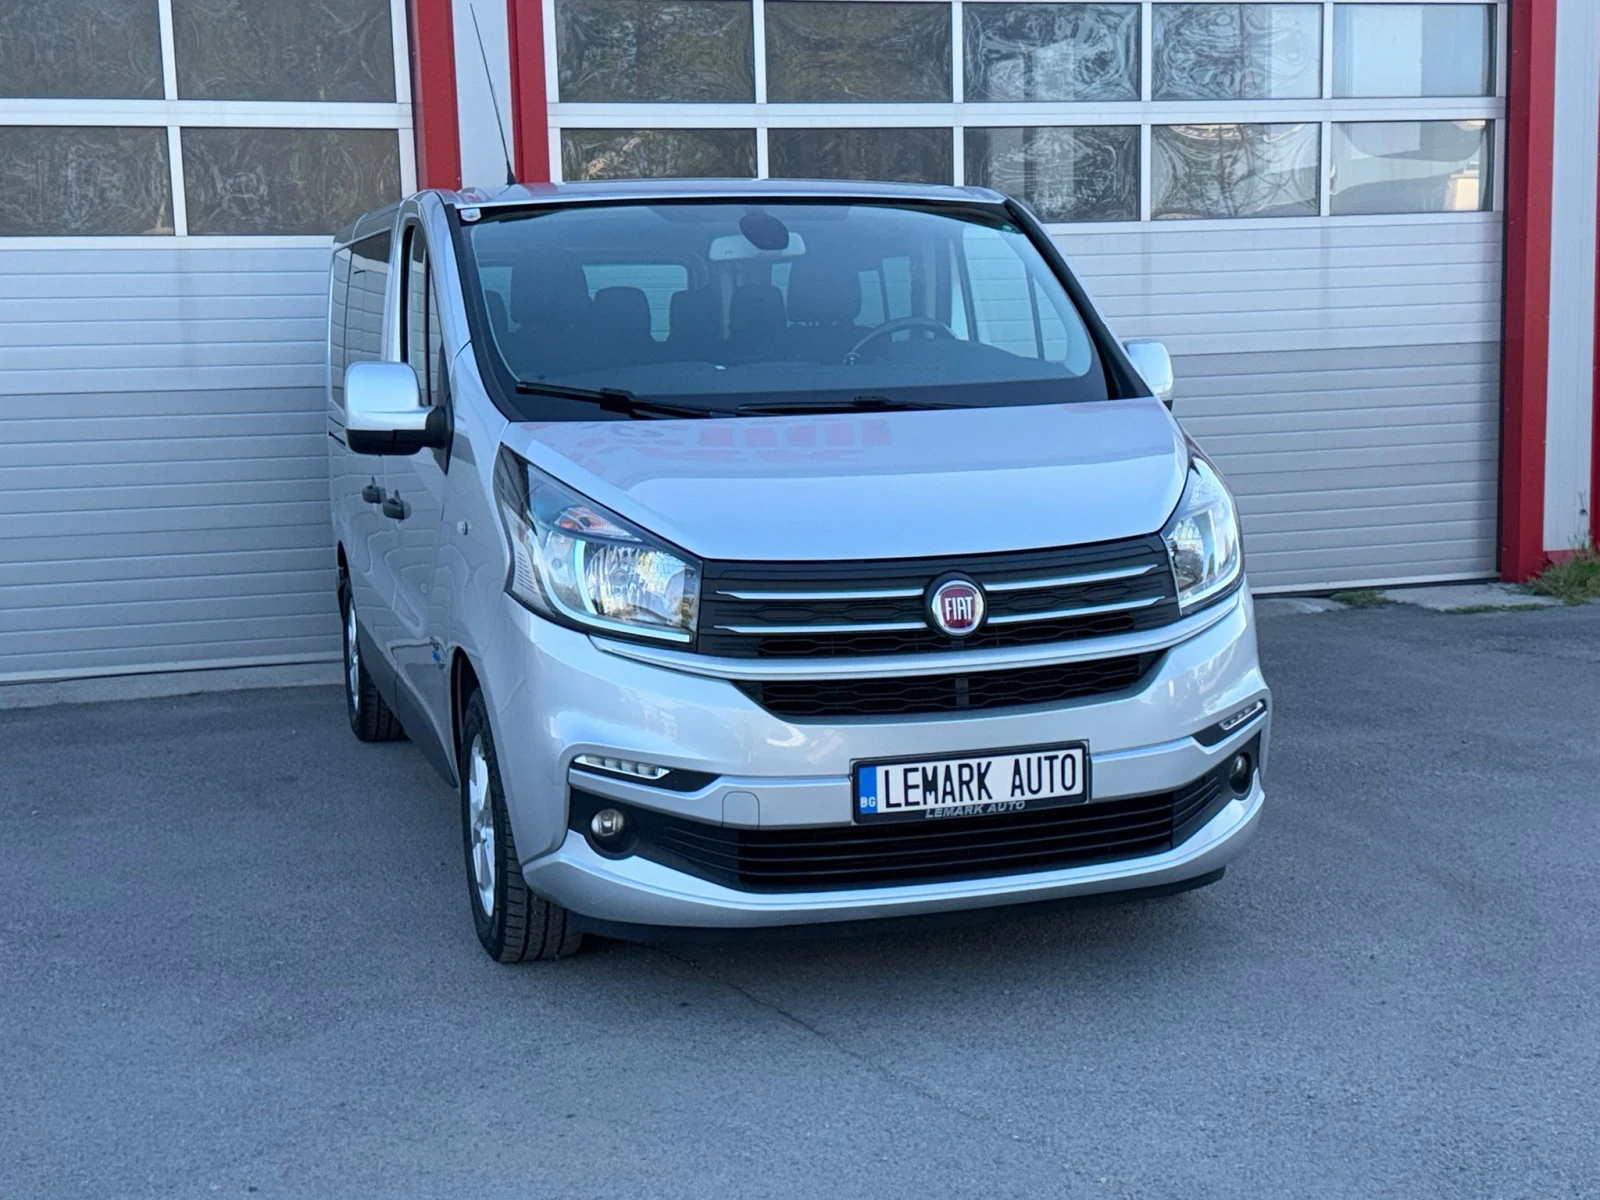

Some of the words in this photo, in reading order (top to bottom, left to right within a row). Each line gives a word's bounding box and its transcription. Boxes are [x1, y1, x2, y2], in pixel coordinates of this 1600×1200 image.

[944, 596, 973, 621] FIAT
[884, 760, 993, 809] LEMARK
[1010, 753, 1076, 797] AUTO
[860, 797, 876, 808] BG
[925, 804, 984, 819] LEMARK
[987, 800, 1026, 813] AUTO
